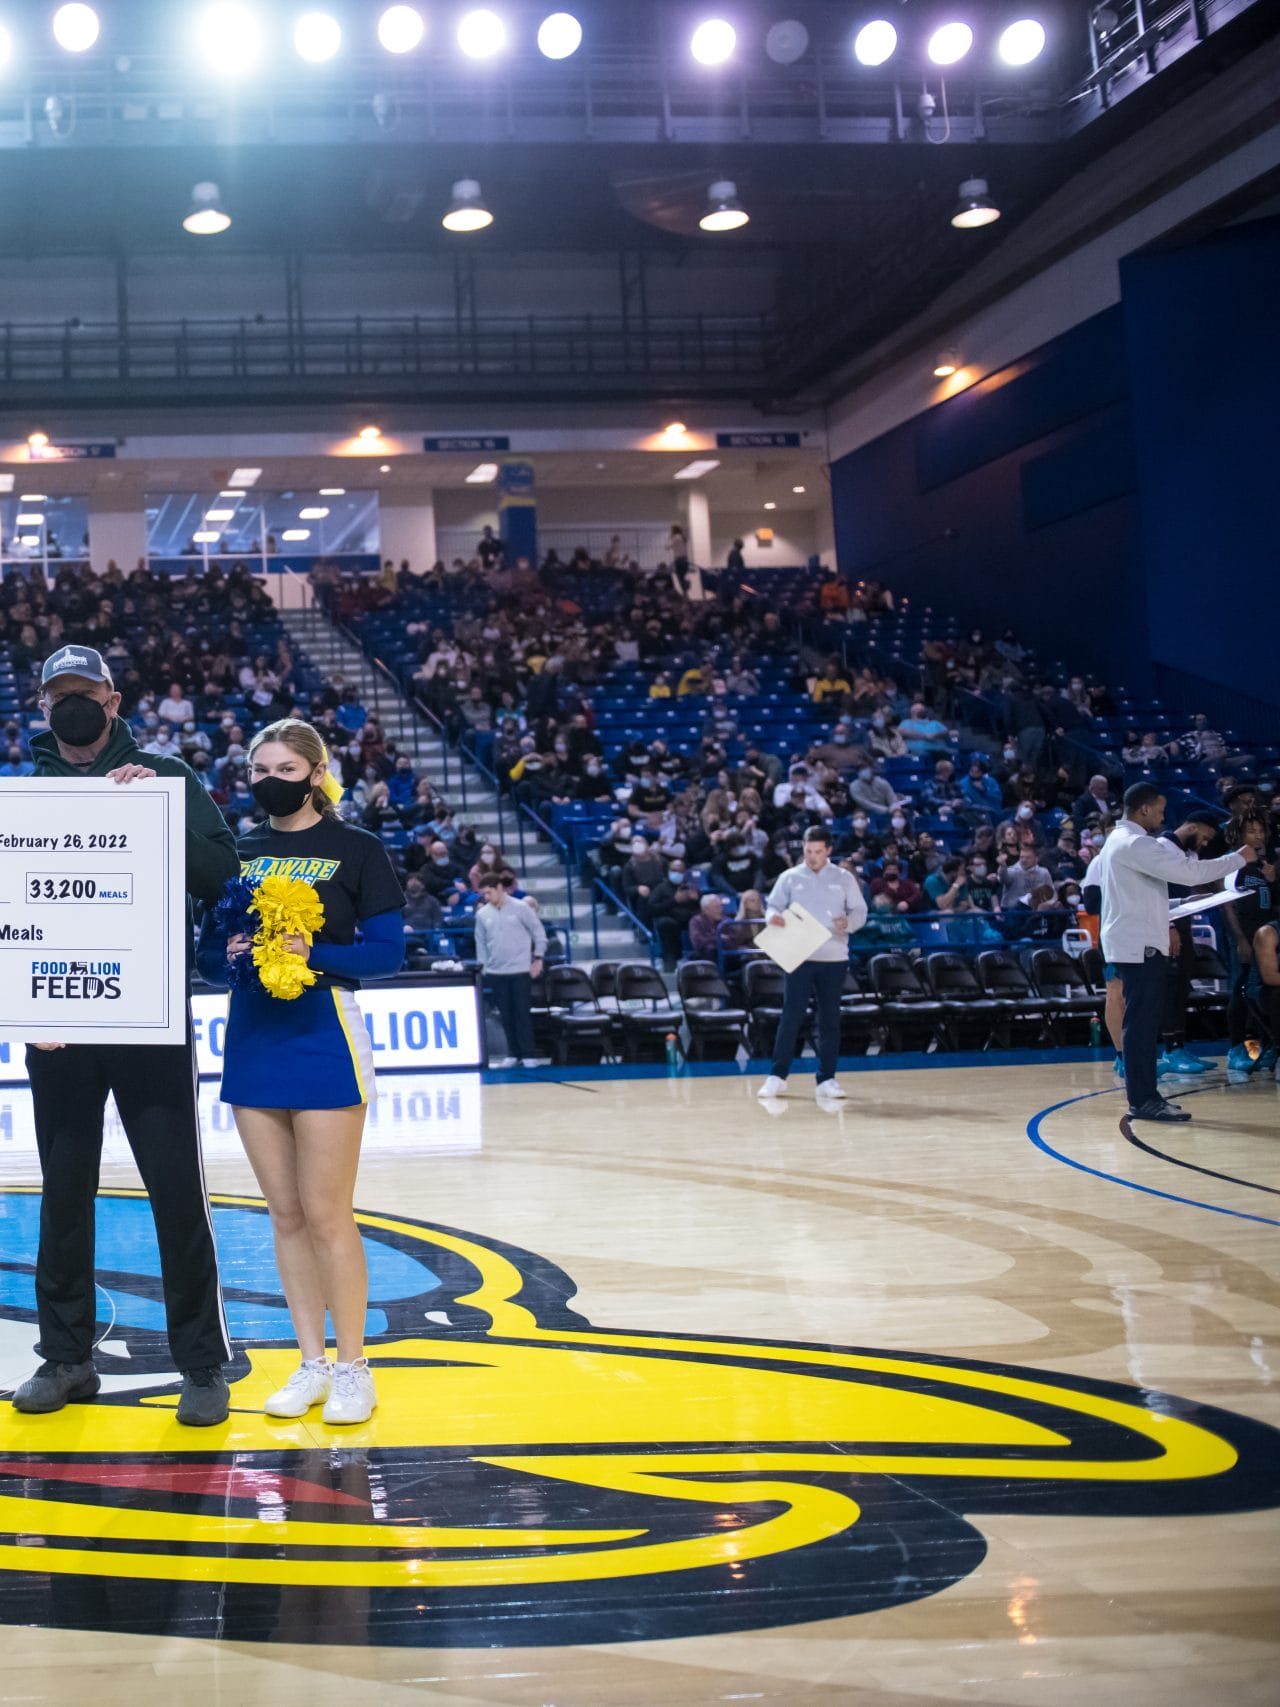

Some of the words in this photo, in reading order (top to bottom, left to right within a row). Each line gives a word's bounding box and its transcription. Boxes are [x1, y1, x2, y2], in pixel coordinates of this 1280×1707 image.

[63, 834, 84, 850] 26,
[88, 834, 128, 849] 2022
[29, 878, 97, 900] 33,200
[99, 891, 128, 899] MEALS
[31, 961, 68, 975] FOOD
[90, 962, 121, 976] LION
[31, 976, 122, 1000] FEEDS
[364, 1009, 459, 1051] LION
